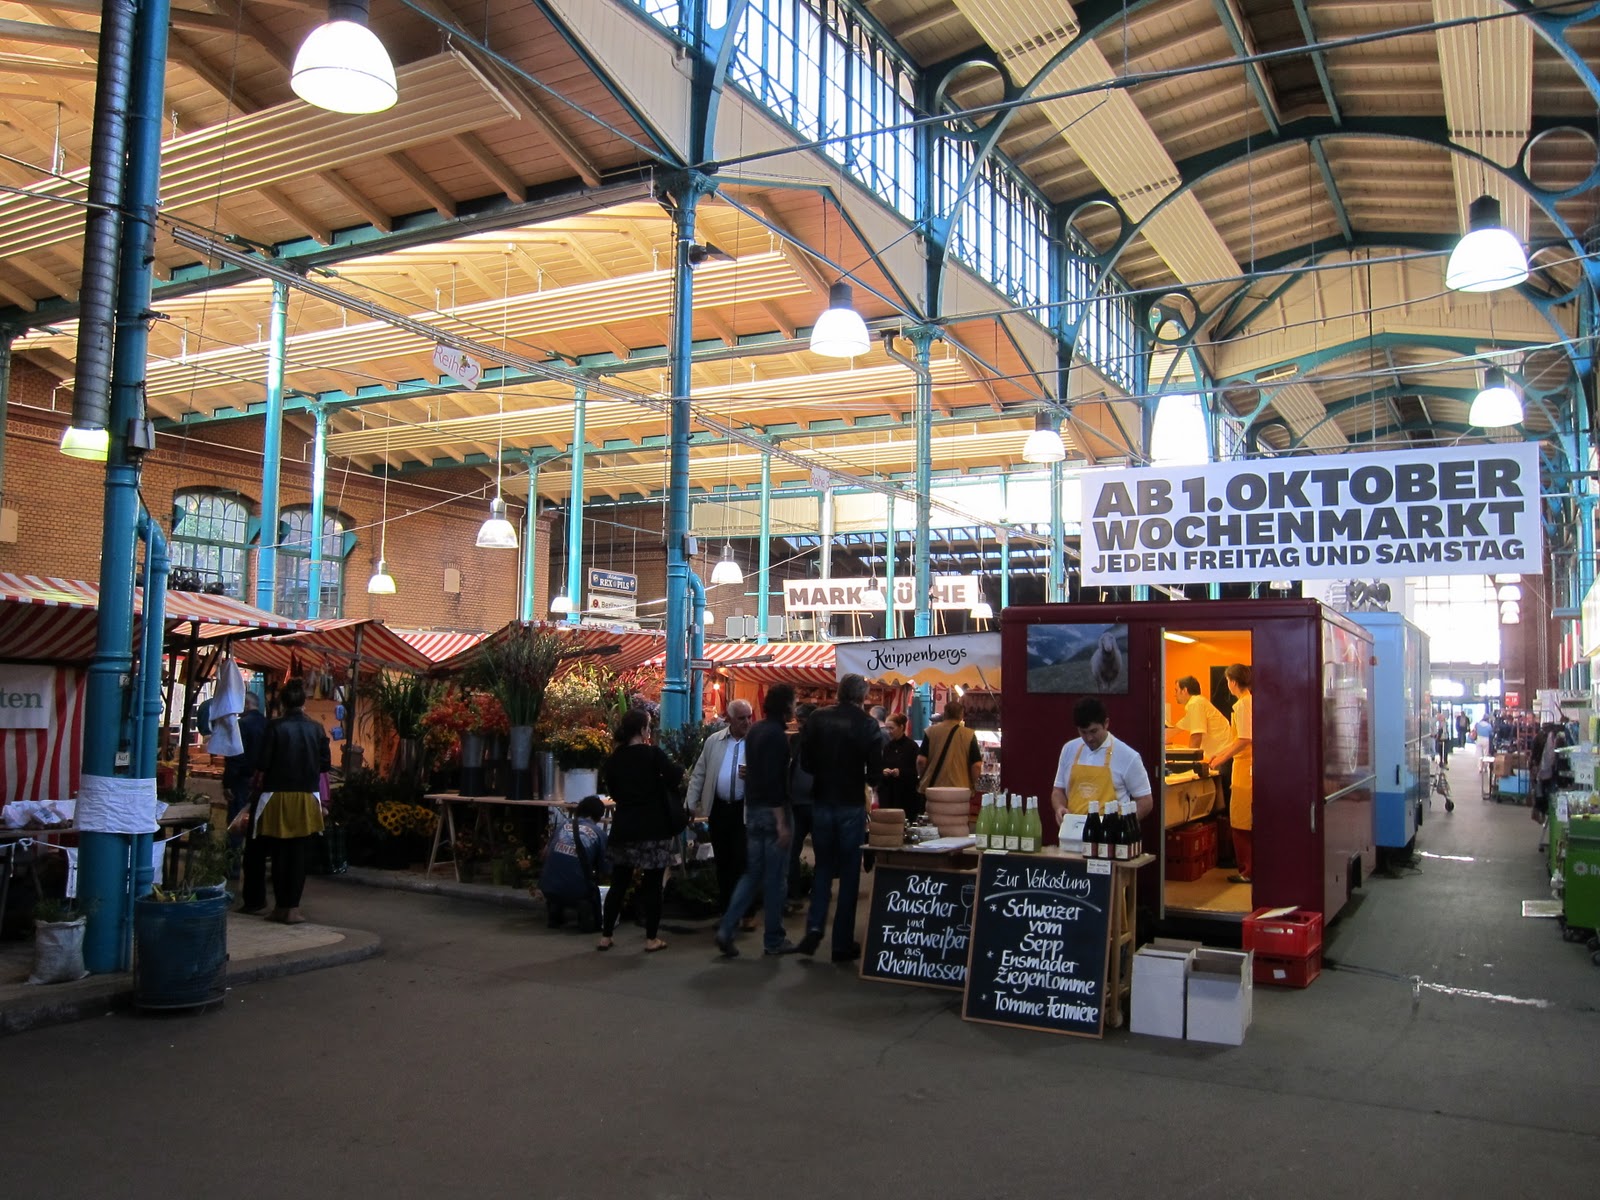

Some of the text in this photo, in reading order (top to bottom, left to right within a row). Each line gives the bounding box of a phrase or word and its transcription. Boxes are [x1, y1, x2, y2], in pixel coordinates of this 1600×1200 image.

[433, 344, 479, 387] Reihe 2
[1093, 478, 1173, 518] AB
[1093, 501, 1525, 551] WOCHENMARKT
[1091, 538, 1525, 574] JEDEN FREITAG UND SAMSTAG
[600, 578, 630, 590] REX PILS
[867, 644, 967, 671] Knippenbergs
[0, 687, 43, 709] ten
[906, 875, 949, 896] Roter
[992, 868, 1020, 888] Zur
[1025, 867, 1091, 899] Verkostung
[885, 891, 958, 918] Rauscher
[1002, 898, 1084, 921] Schweizer
[906, 917, 926, 929] und
[1028, 920, 1063, 936] vom
[882, 926, 970, 960] Federweißer
[904, 947, 921, 957] aus
[1020, 933, 1064, 961] Sepp
[993, 966, 1096, 995] Ziegentomme
[994, 990, 1100, 1023] Tomme Fermière
